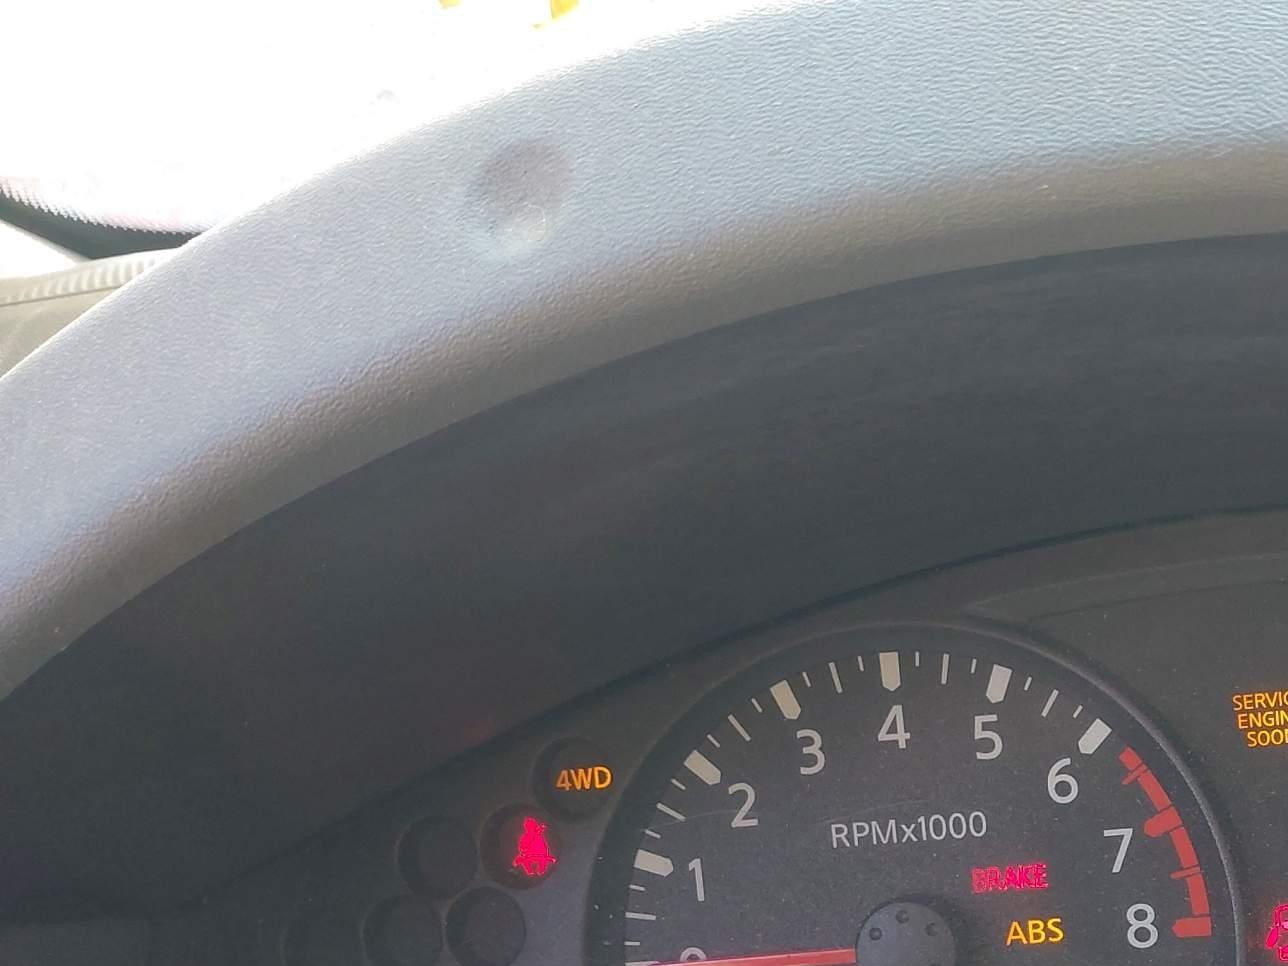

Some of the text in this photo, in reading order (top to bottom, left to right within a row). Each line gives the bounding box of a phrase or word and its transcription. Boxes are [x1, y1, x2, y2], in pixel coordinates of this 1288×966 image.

[877, 704, 911, 749] 4
[973, 714, 1003, 760] 5
[796, 730, 826, 776] 3
[555, 765, 613, 792] 4WD
[1046, 757, 1080, 805] 6
[727, 783, 759, 829] 2
[831, 811, 988, 849] RPMx1000
[1103, 828, 1134, 874] 7
[687, 858, 706, 902] 1
[971, 862, 1049, 894] BRAKE
[1006, 916, 1065, 947] ABS
[1126, 903, 1159, 949] 8
